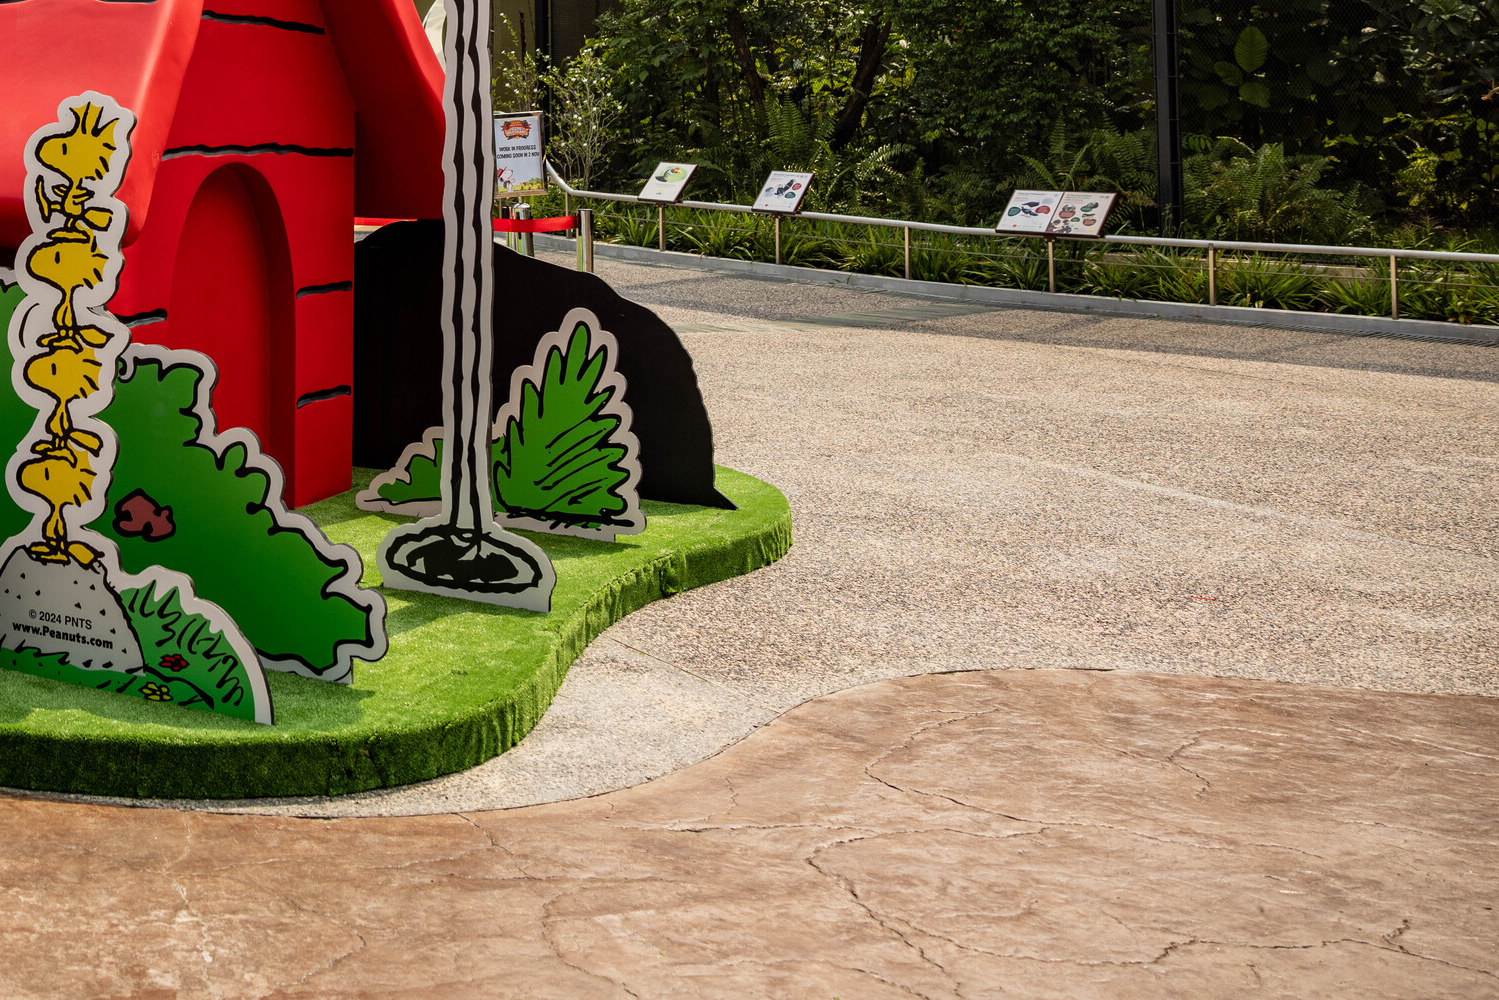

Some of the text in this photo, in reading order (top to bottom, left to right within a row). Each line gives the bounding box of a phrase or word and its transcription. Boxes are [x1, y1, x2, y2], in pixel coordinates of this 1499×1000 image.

[39, 611, 62, 623] 2024
[64, 616, 92, 630] PNTS
[12, 621, 113, 649] www.Peanuts.com
